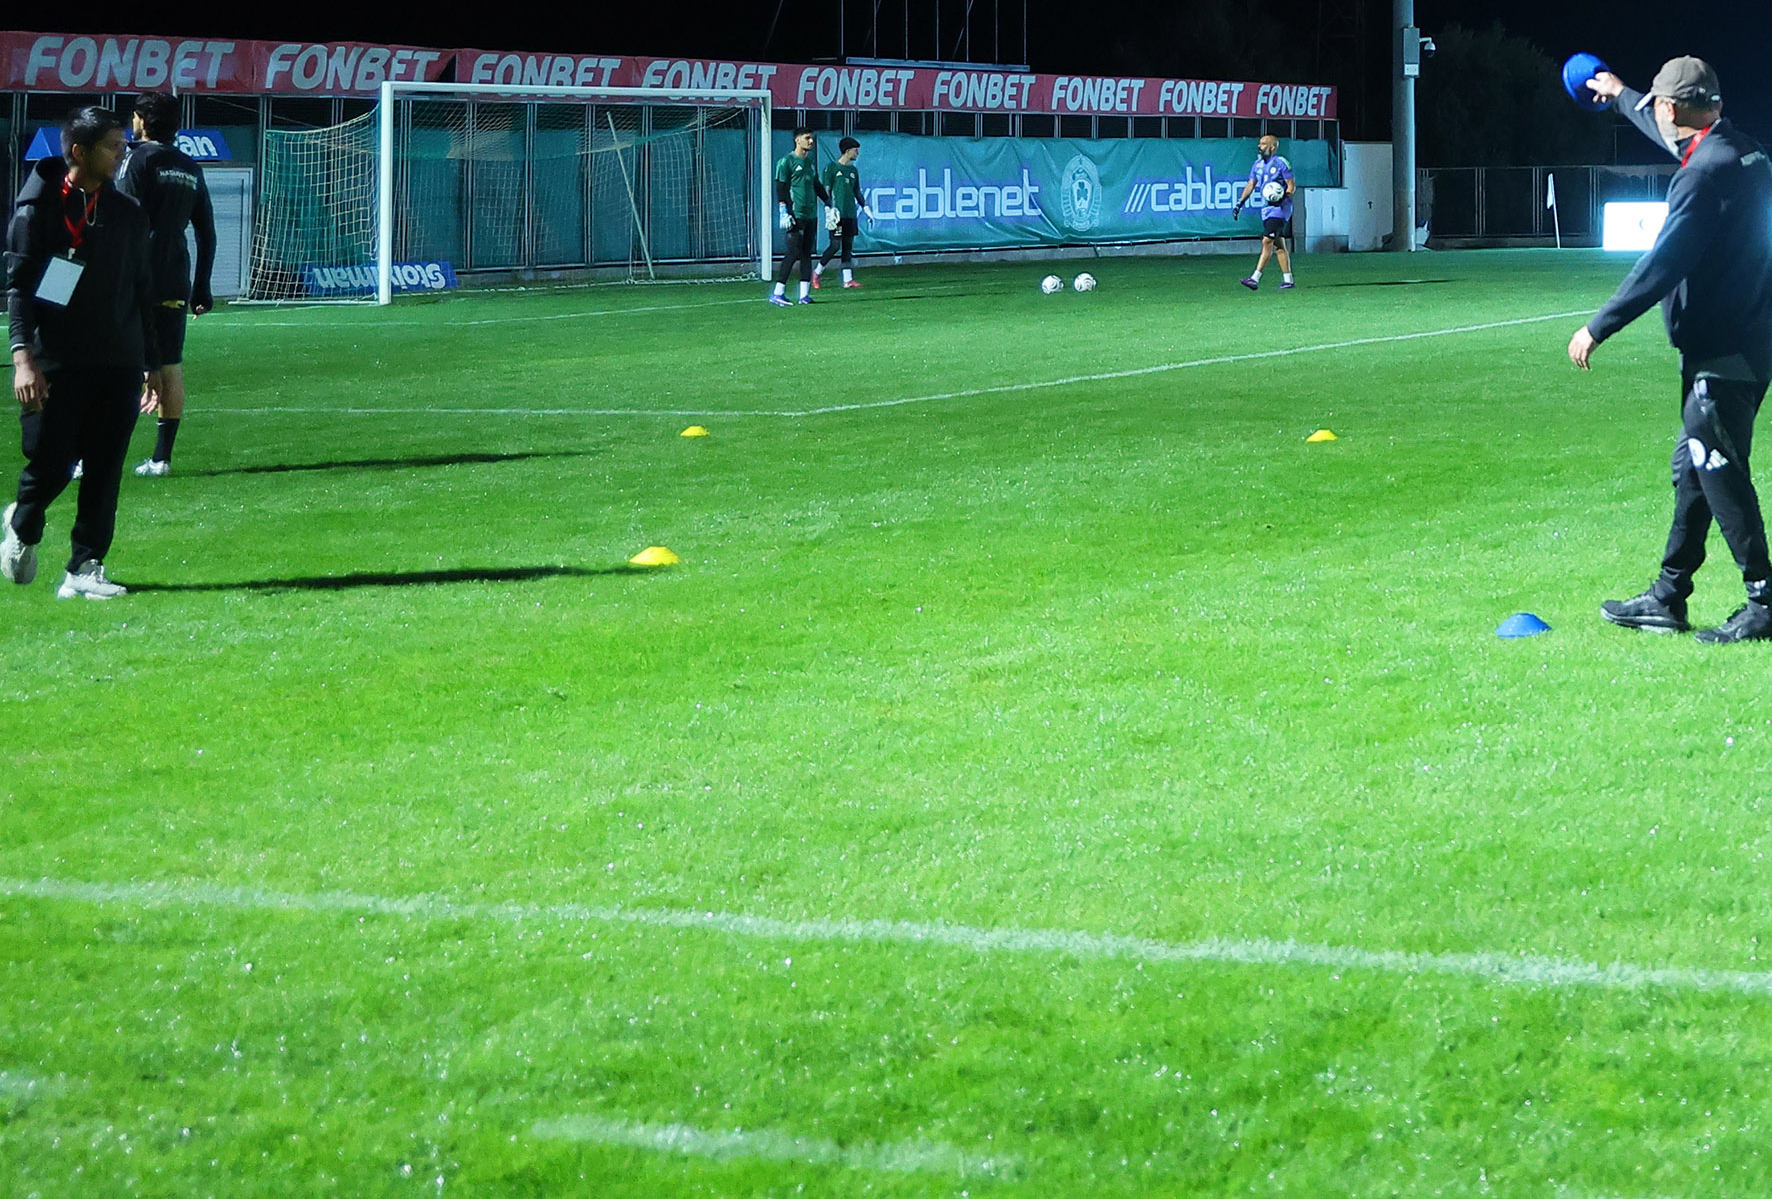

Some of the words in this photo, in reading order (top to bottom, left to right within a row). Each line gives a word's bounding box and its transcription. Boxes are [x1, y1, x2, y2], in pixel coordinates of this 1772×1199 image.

[24, 35, 235, 88] FONBET
[265, 44, 440, 91] FONBET
[470, 53, 622, 98] FONBET
[641, 59, 777, 100] FONBET
[797, 67, 914, 106] FONBET
[932, 71, 1036, 109] FONBET
[1051, 76, 1145, 112] FONBET
[1158, 80, 1245, 115] FONBET
[1256, 84, 1332, 117] FONBET
[870, 168, 1043, 220] cablenet
[1151, 166, 1267, 212] cablene
